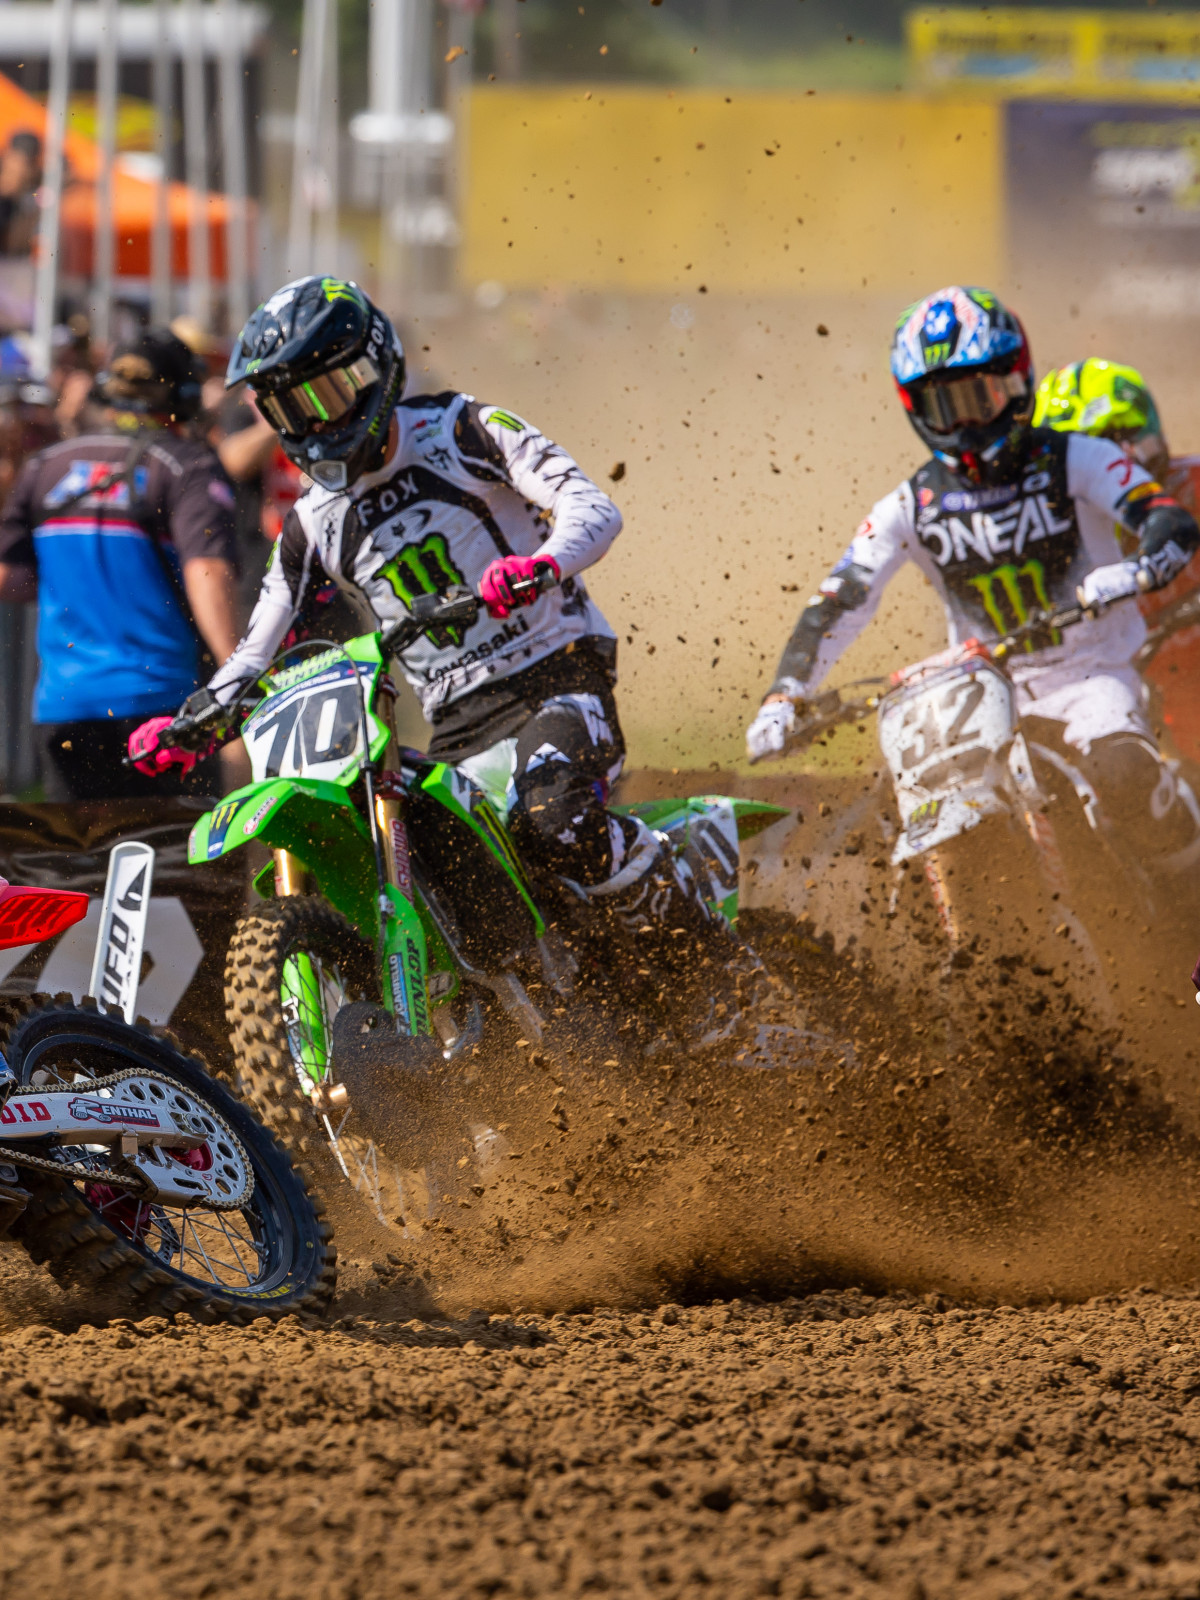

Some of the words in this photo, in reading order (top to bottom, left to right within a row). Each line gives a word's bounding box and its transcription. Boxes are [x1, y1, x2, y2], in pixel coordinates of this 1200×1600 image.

[366, 315, 386, 361] FOX
[356, 473, 420, 527] FOX
[253, 683, 362, 778] 70
[406, 937, 435, 1035] DUNLOP
[0, 1101, 52, 1125] D.I.D
